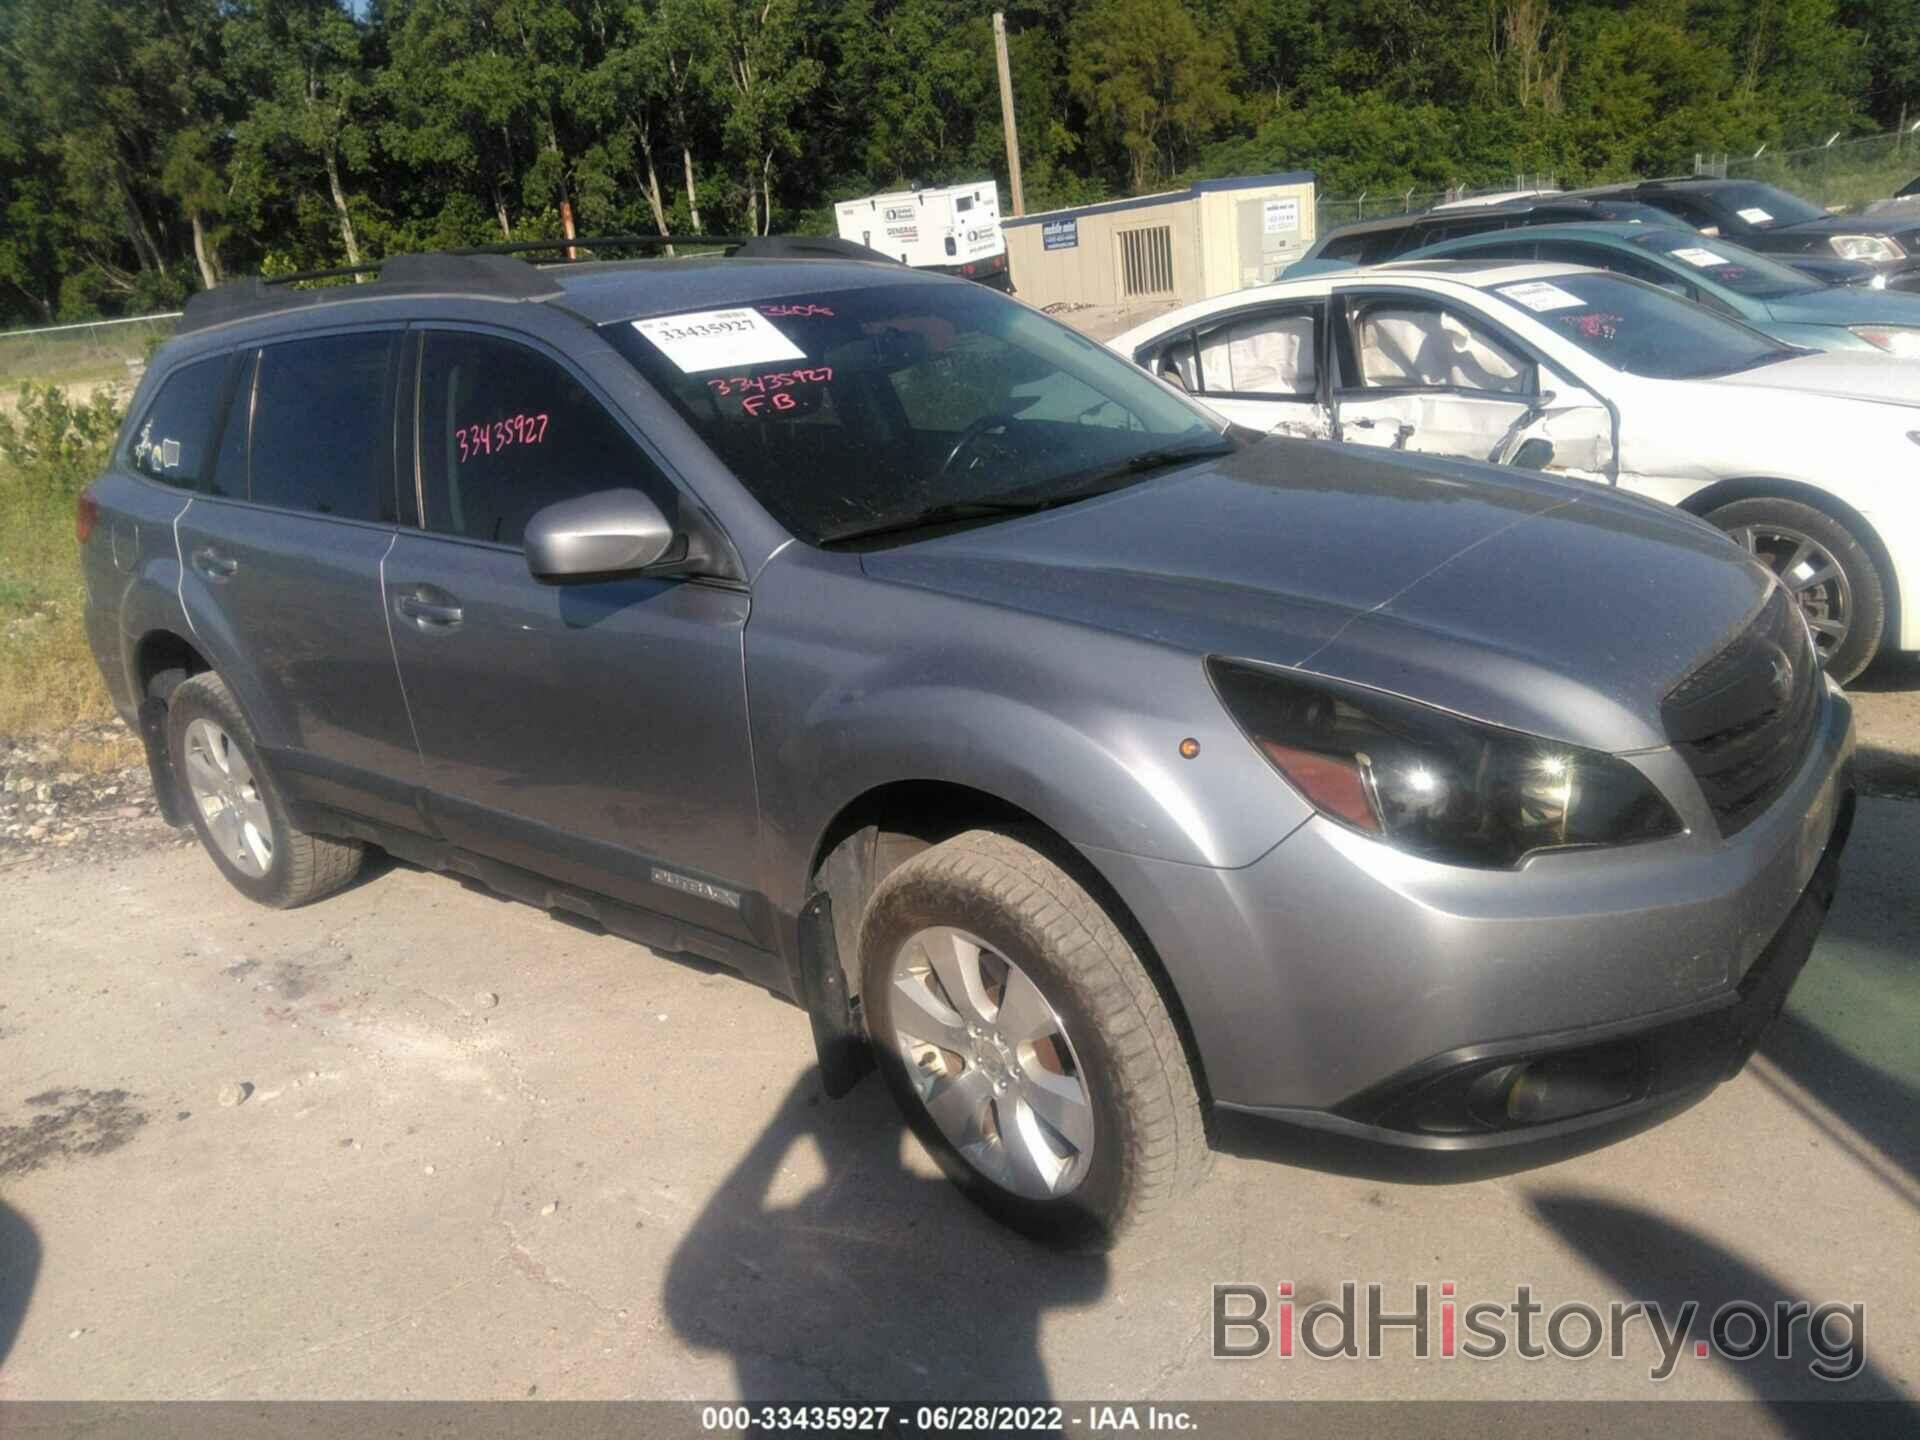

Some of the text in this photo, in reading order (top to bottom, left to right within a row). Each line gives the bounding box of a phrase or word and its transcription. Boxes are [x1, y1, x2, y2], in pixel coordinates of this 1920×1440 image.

[659, 319, 756, 341] 33435927
[708, 367, 832, 396] 33435927
[456, 414, 548, 463] 33435927
